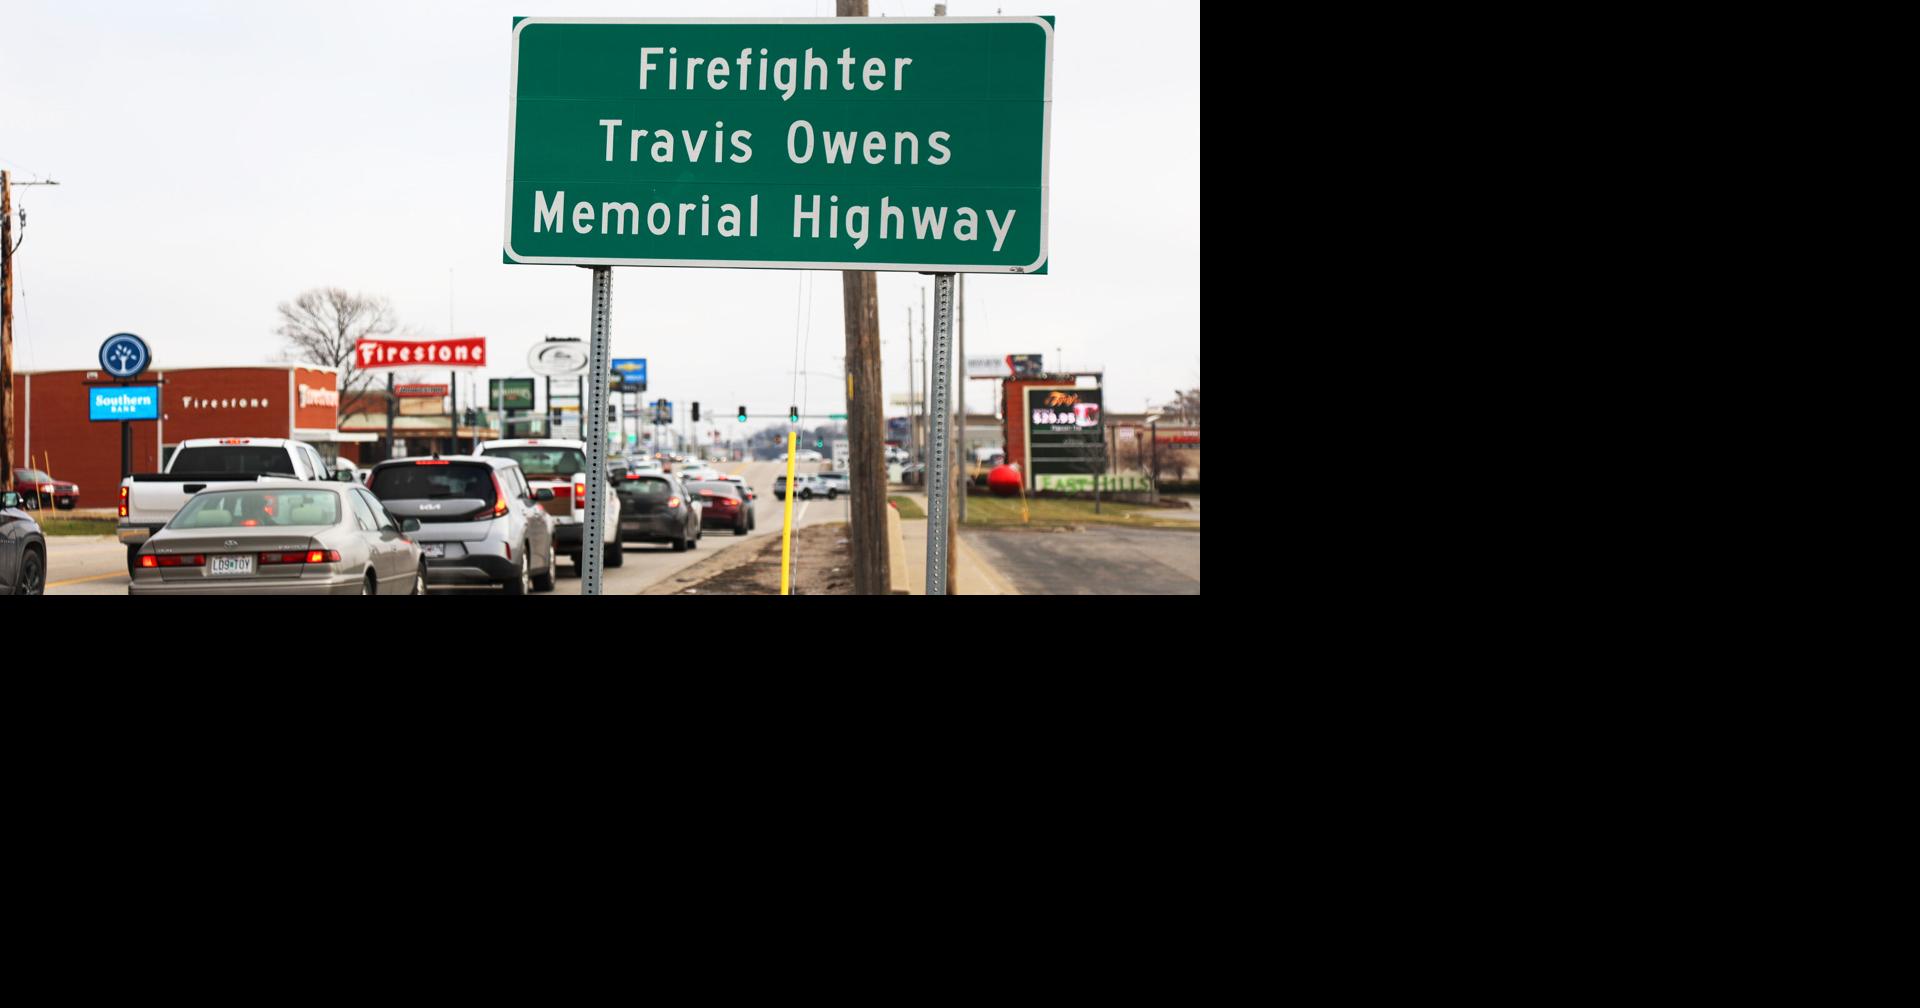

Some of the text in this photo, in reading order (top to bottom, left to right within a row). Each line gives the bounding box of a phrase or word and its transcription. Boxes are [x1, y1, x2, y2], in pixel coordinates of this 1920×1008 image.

[639, 47, 913, 101] Firefighter
[599, 119, 951, 165] Travis Owens
[533, 190, 1016, 251] Memorial Highway
[359, 342, 483, 365] Firestone
[95, 394, 152, 406] Southern
[111, 405, 136, 413] BANK
[182, 396, 269, 408] Firestone
